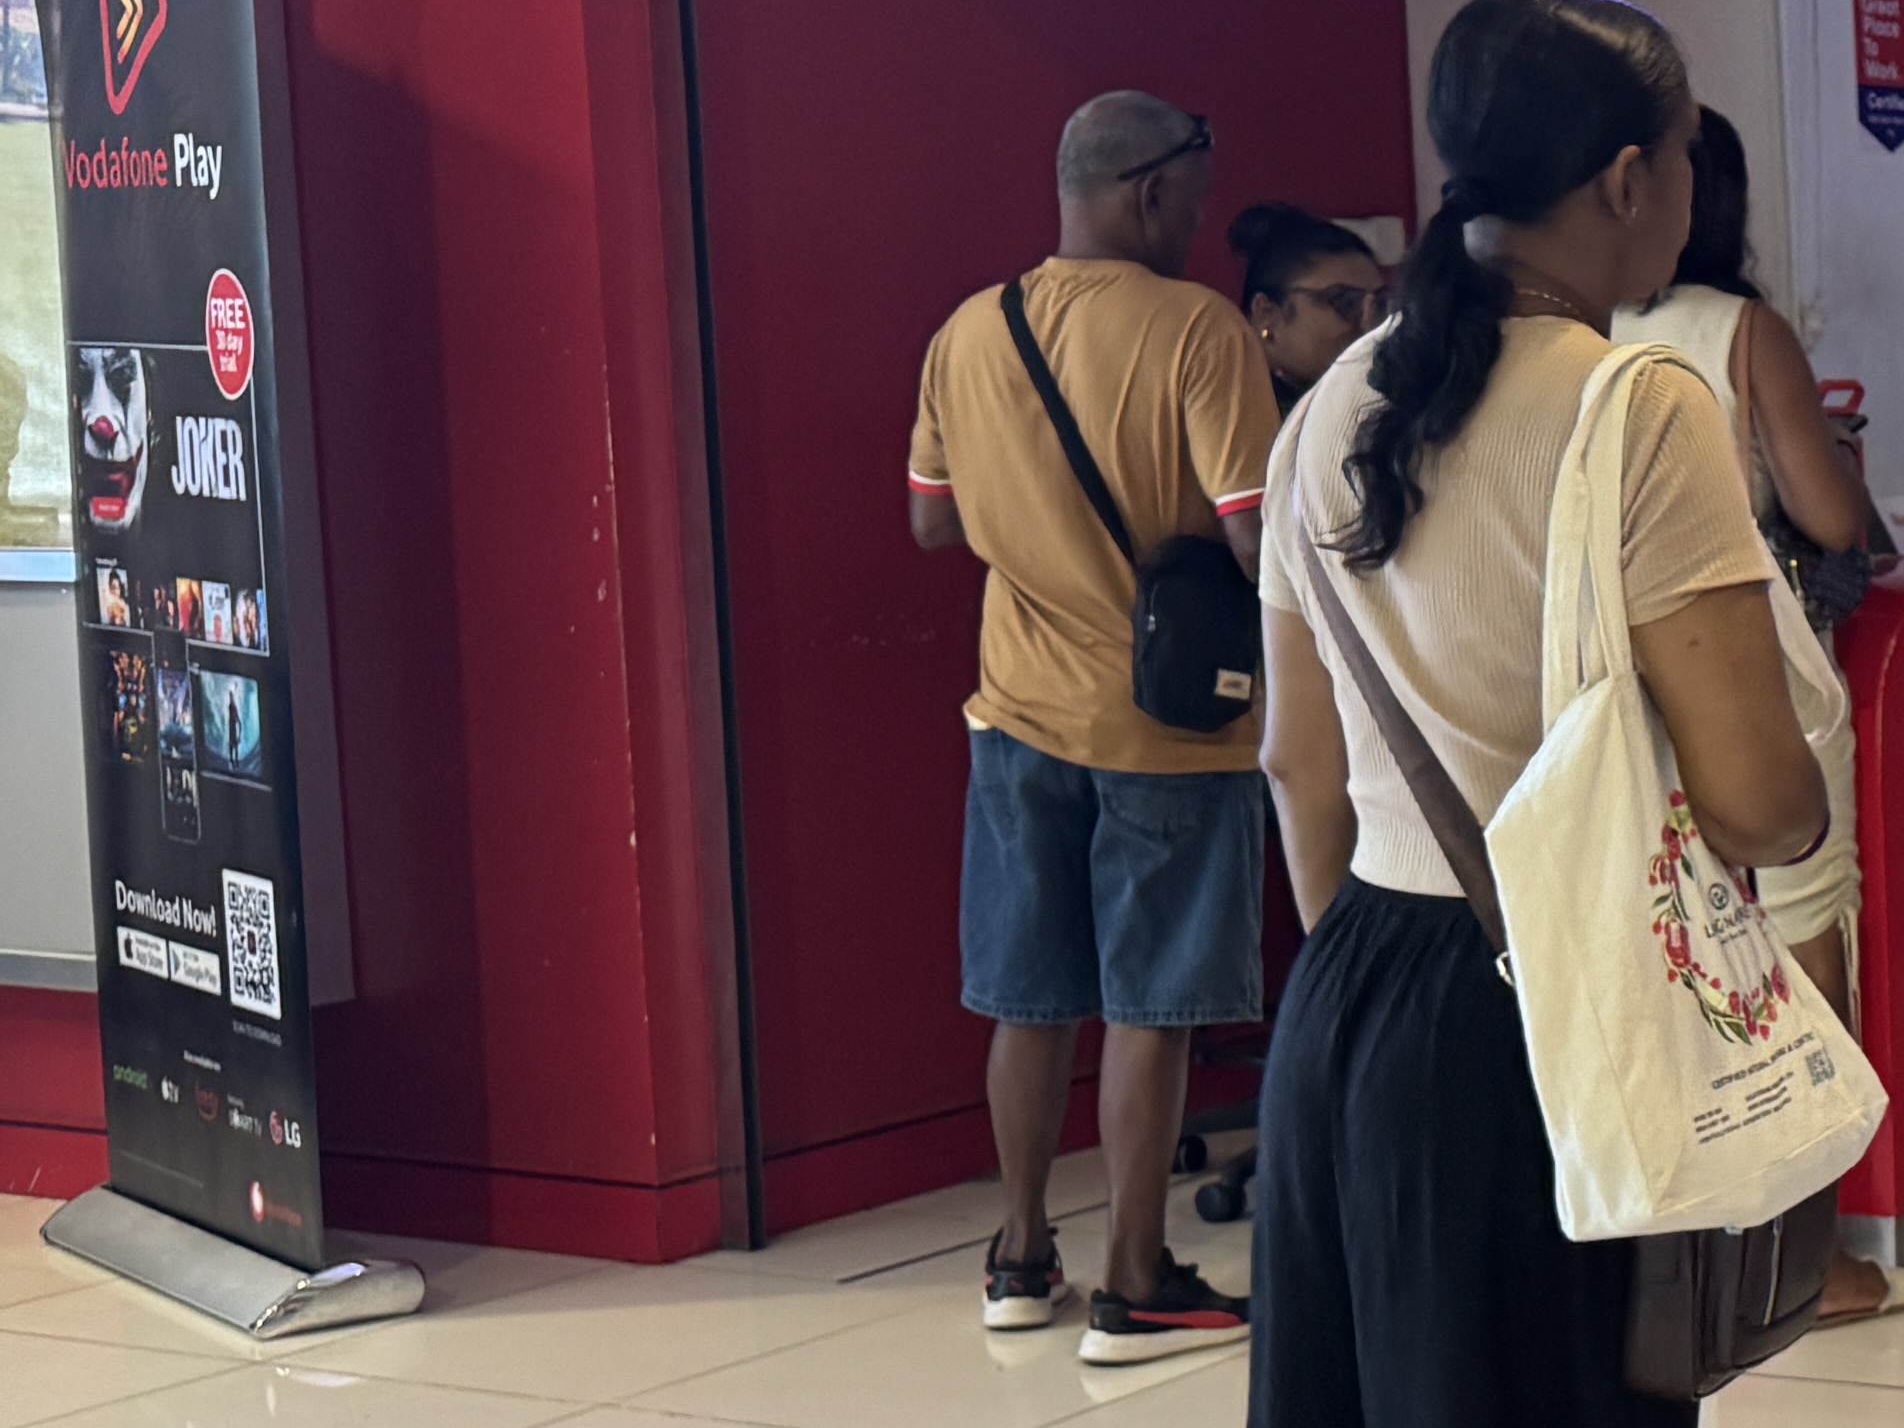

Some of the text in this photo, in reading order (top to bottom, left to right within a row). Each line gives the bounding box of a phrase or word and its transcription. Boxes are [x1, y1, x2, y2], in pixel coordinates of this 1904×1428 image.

[1863, 36, 1879, 58] To
[65, 131, 223, 200] Vodafone Play
[210, 297, 246, 329] FREE
[226, 329, 244, 356] day
[171, 415, 247, 502] JOKER
[115, 879, 218, 938] Download Now!
[283, 1117, 302, 1149] LG
